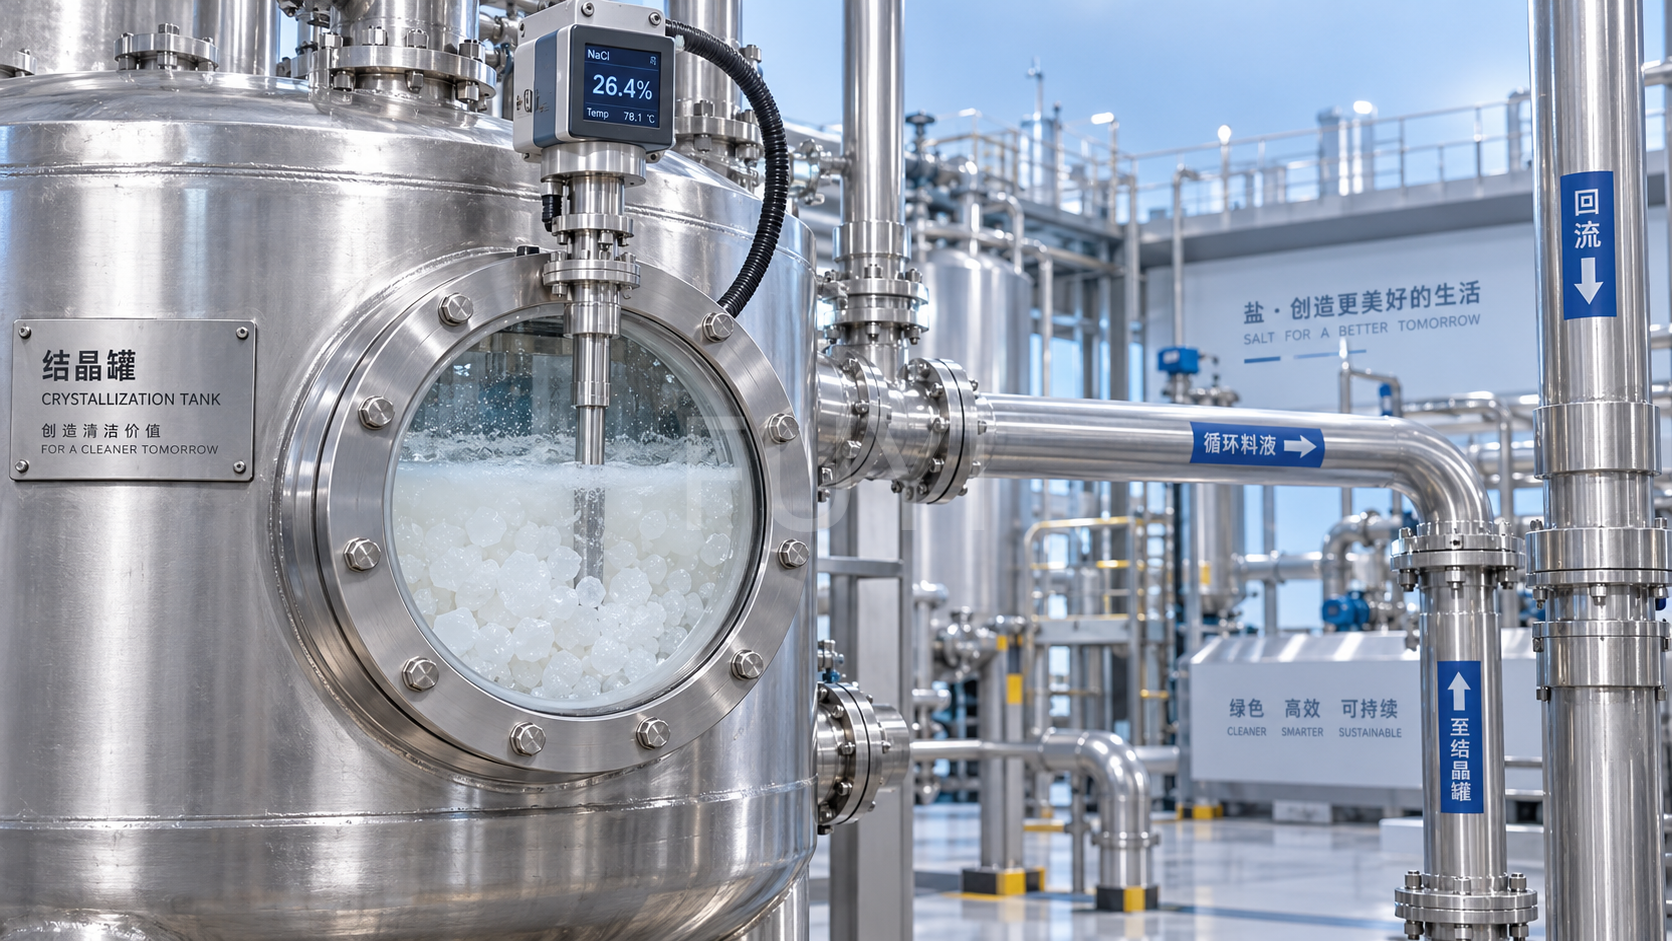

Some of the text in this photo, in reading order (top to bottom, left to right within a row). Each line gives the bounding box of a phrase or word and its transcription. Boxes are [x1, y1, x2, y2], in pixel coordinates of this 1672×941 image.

[587, 49, 610, 61] NaCl
[592, 74, 653, 100] 26.4%
[586, 107, 609, 119] Temp
[623, 111, 642, 122] 78.1
[1574, 188, 1601, 249] 回流
[1243, 313, 1481, 345] SALT FOR A BETTER TOMORROW
[42, 349, 136, 382] 结晶罐
[41, 392, 221, 406] CRYSTALLIZATION TANK
[41, 423, 161, 439] 创造清洁价值
[41, 444, 219, 454] FOR A CLEANER TOMORROW
[1203, 432, 1277, 456] 循环料液
[1229, 698, 1398, 720] 绿色 高效 可持续
[1227, 726, 1402, 738] CLEANER SMARTER SUSTAINABLE
[1450, 717, 1472, 802] 至结晶罐
